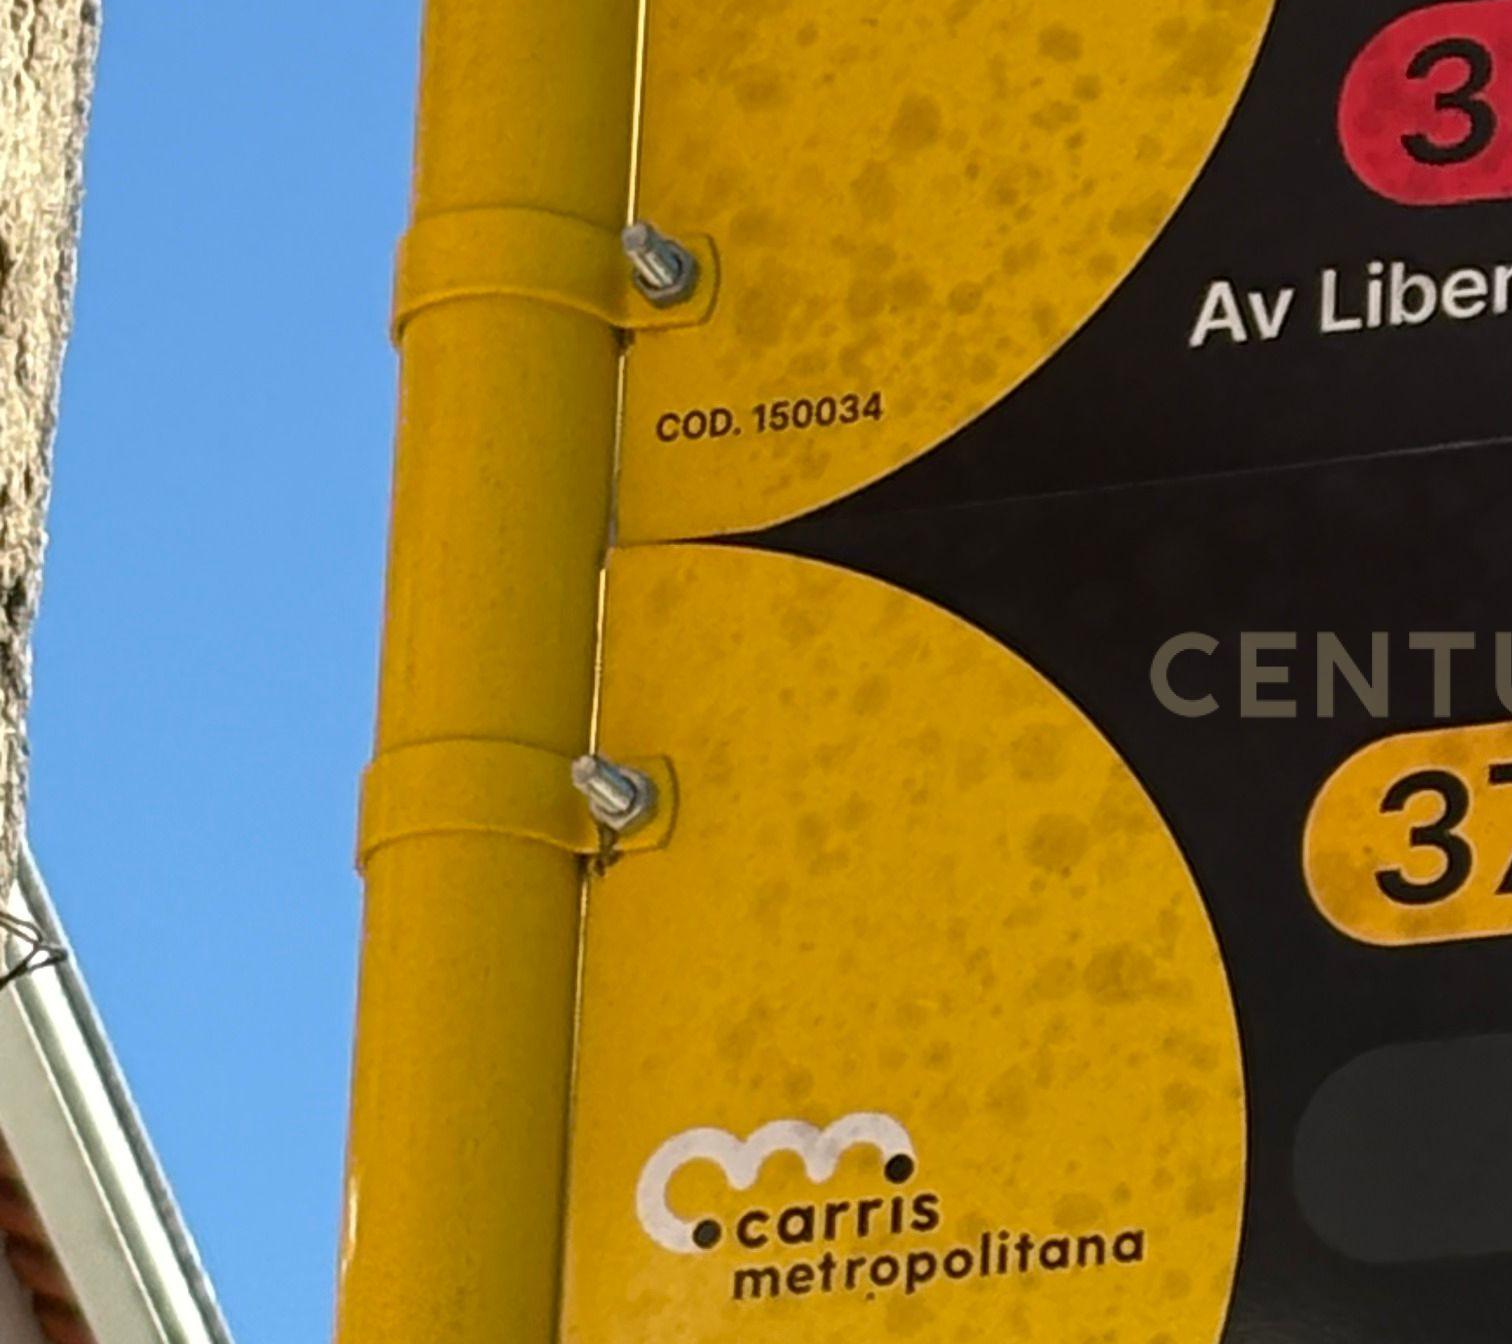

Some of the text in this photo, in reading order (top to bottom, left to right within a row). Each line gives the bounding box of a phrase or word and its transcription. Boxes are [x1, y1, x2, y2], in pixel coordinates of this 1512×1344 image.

[1189, 275, 1294, 347] Av
[656, 391, 884, 443] COD. 150034
[735, 1192, 940, 1249] carris
[732, 1228, 1146, 1301] metropolitana
